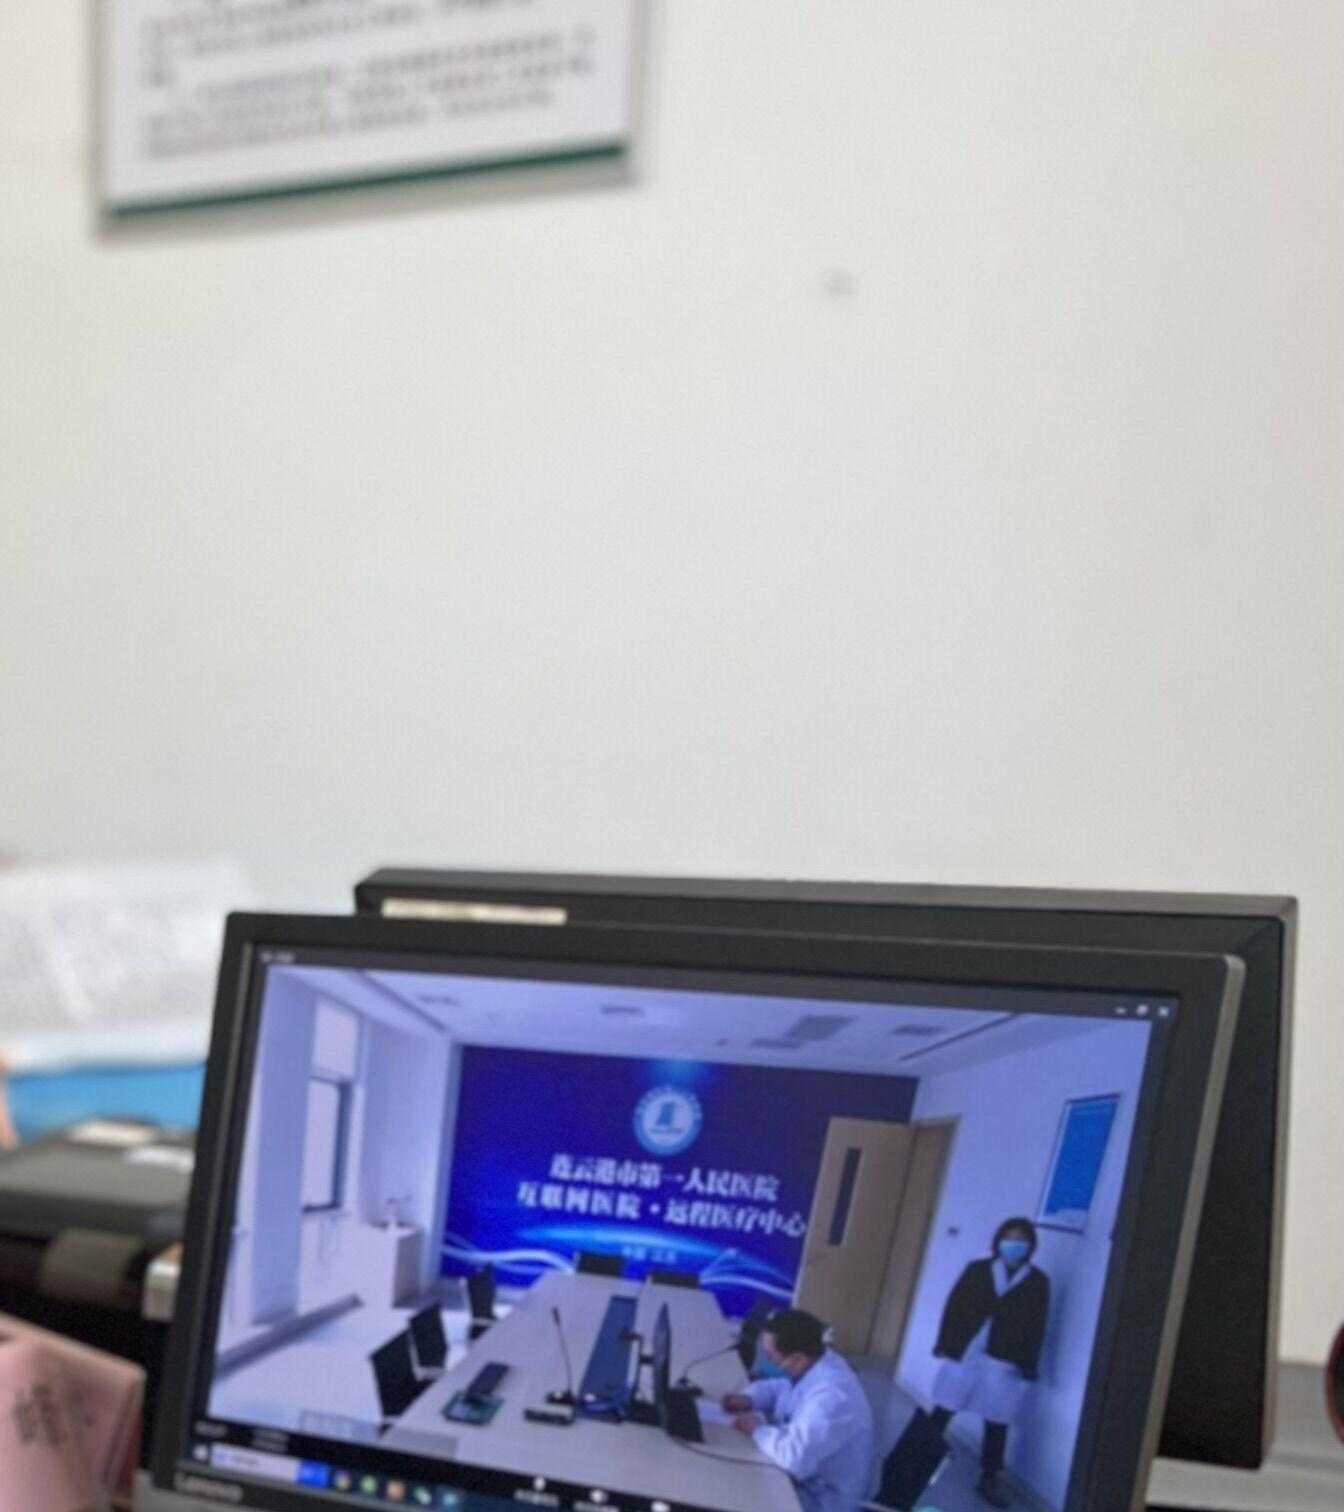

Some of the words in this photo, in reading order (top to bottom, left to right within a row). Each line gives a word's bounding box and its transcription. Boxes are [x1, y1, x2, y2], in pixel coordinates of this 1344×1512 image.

[550, 1154, 781, 1202] 连云港市第一人民医院
